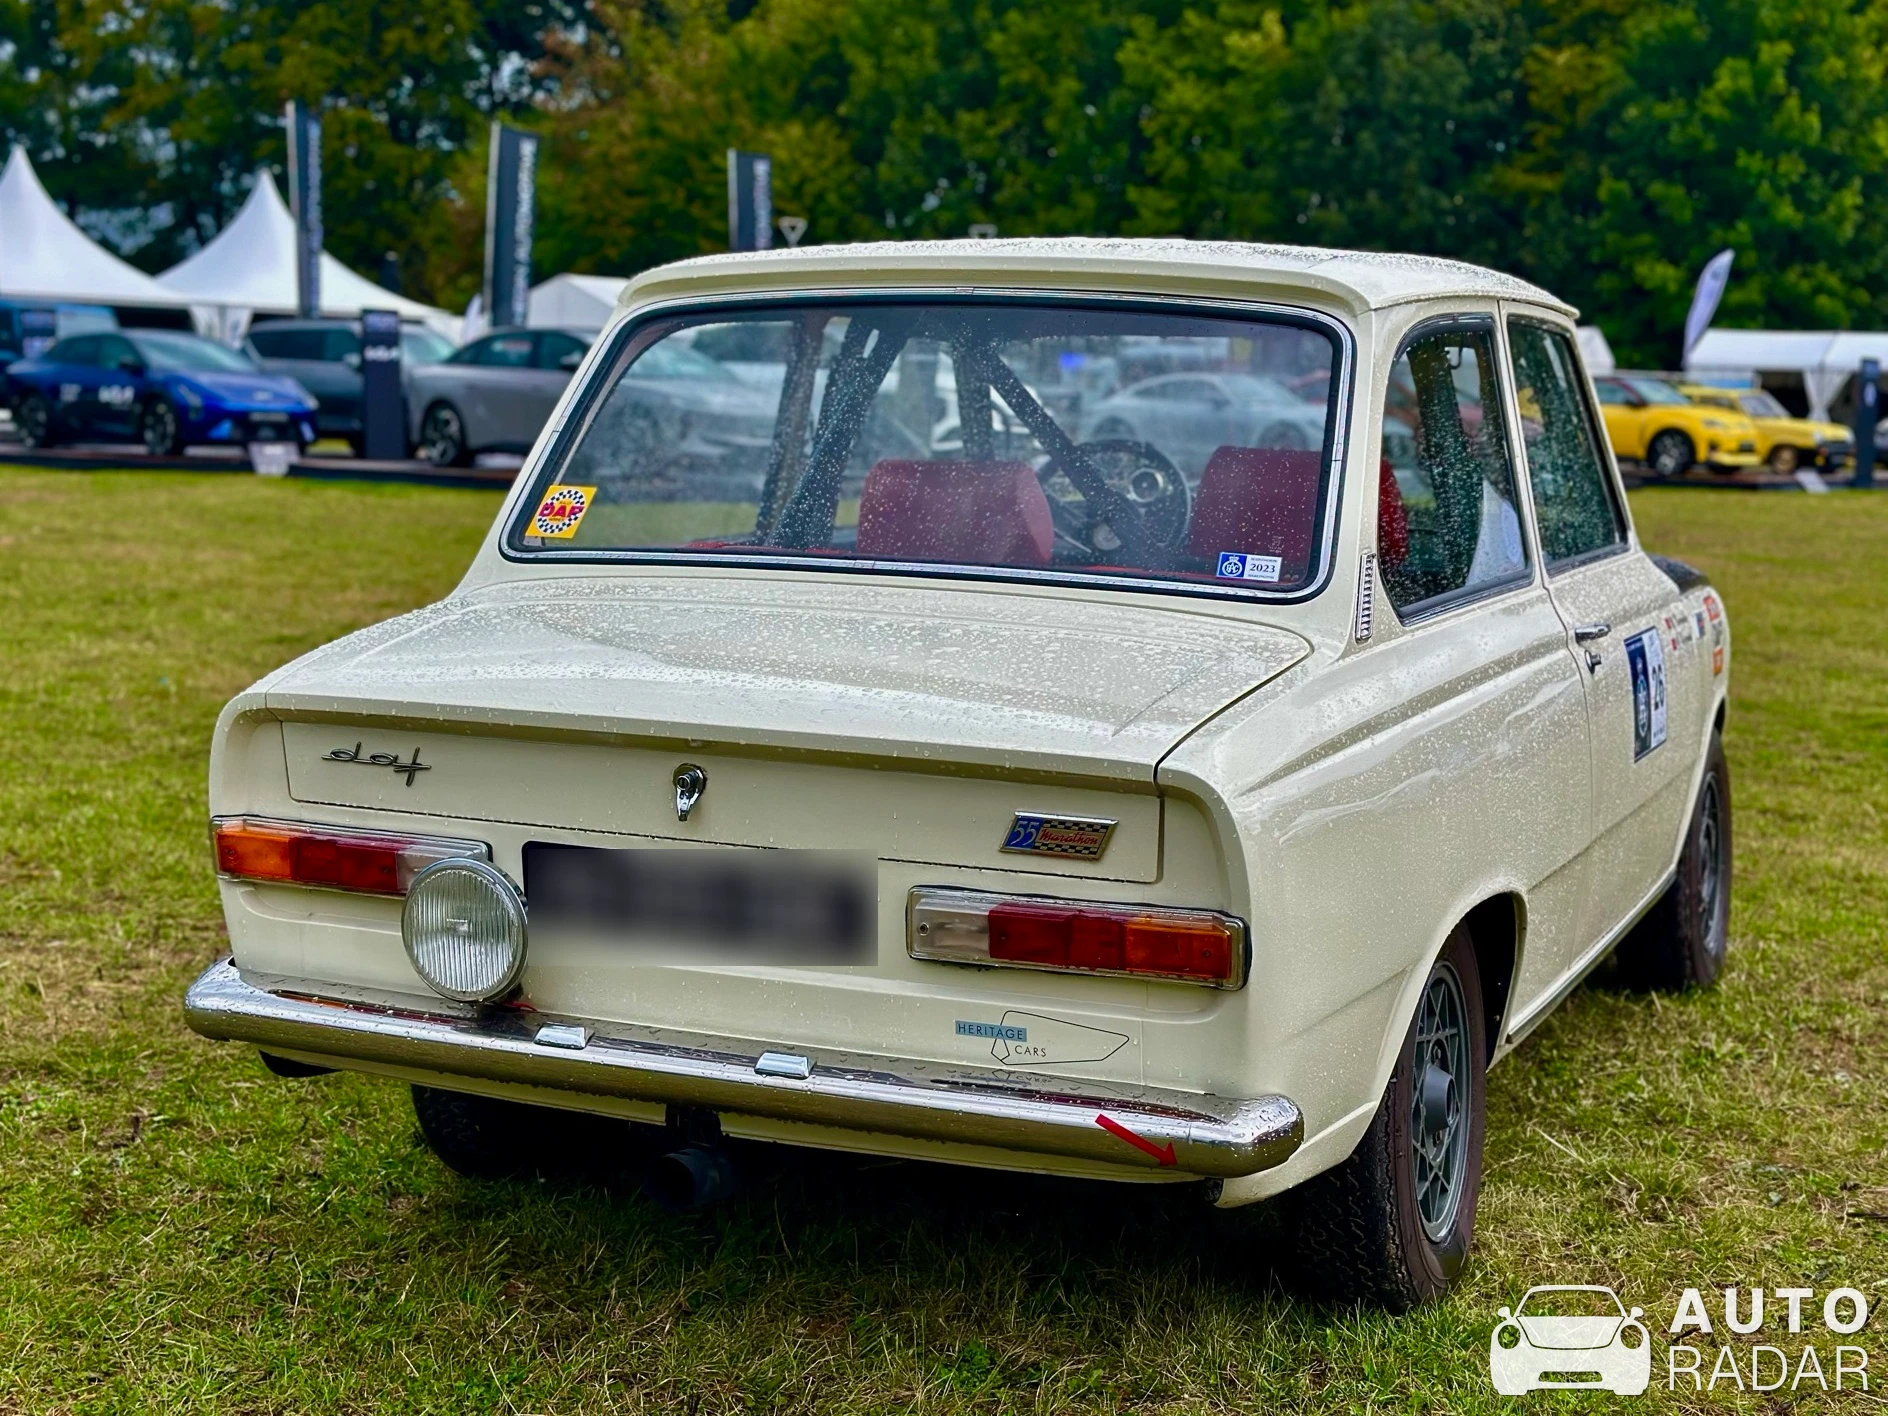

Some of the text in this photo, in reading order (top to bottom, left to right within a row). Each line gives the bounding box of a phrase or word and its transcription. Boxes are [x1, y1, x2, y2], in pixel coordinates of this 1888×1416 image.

[539, 502, 584, 518] DAF
[1249, 563, 1275, 573] 2023
[321, 741, 432, 787] daf
[1010, 821, 1099, 846] 55 Marathon
[957, 1023, 1024, 1040] HERITAGE
[1014, 1045, 1047, 1058] CARS
